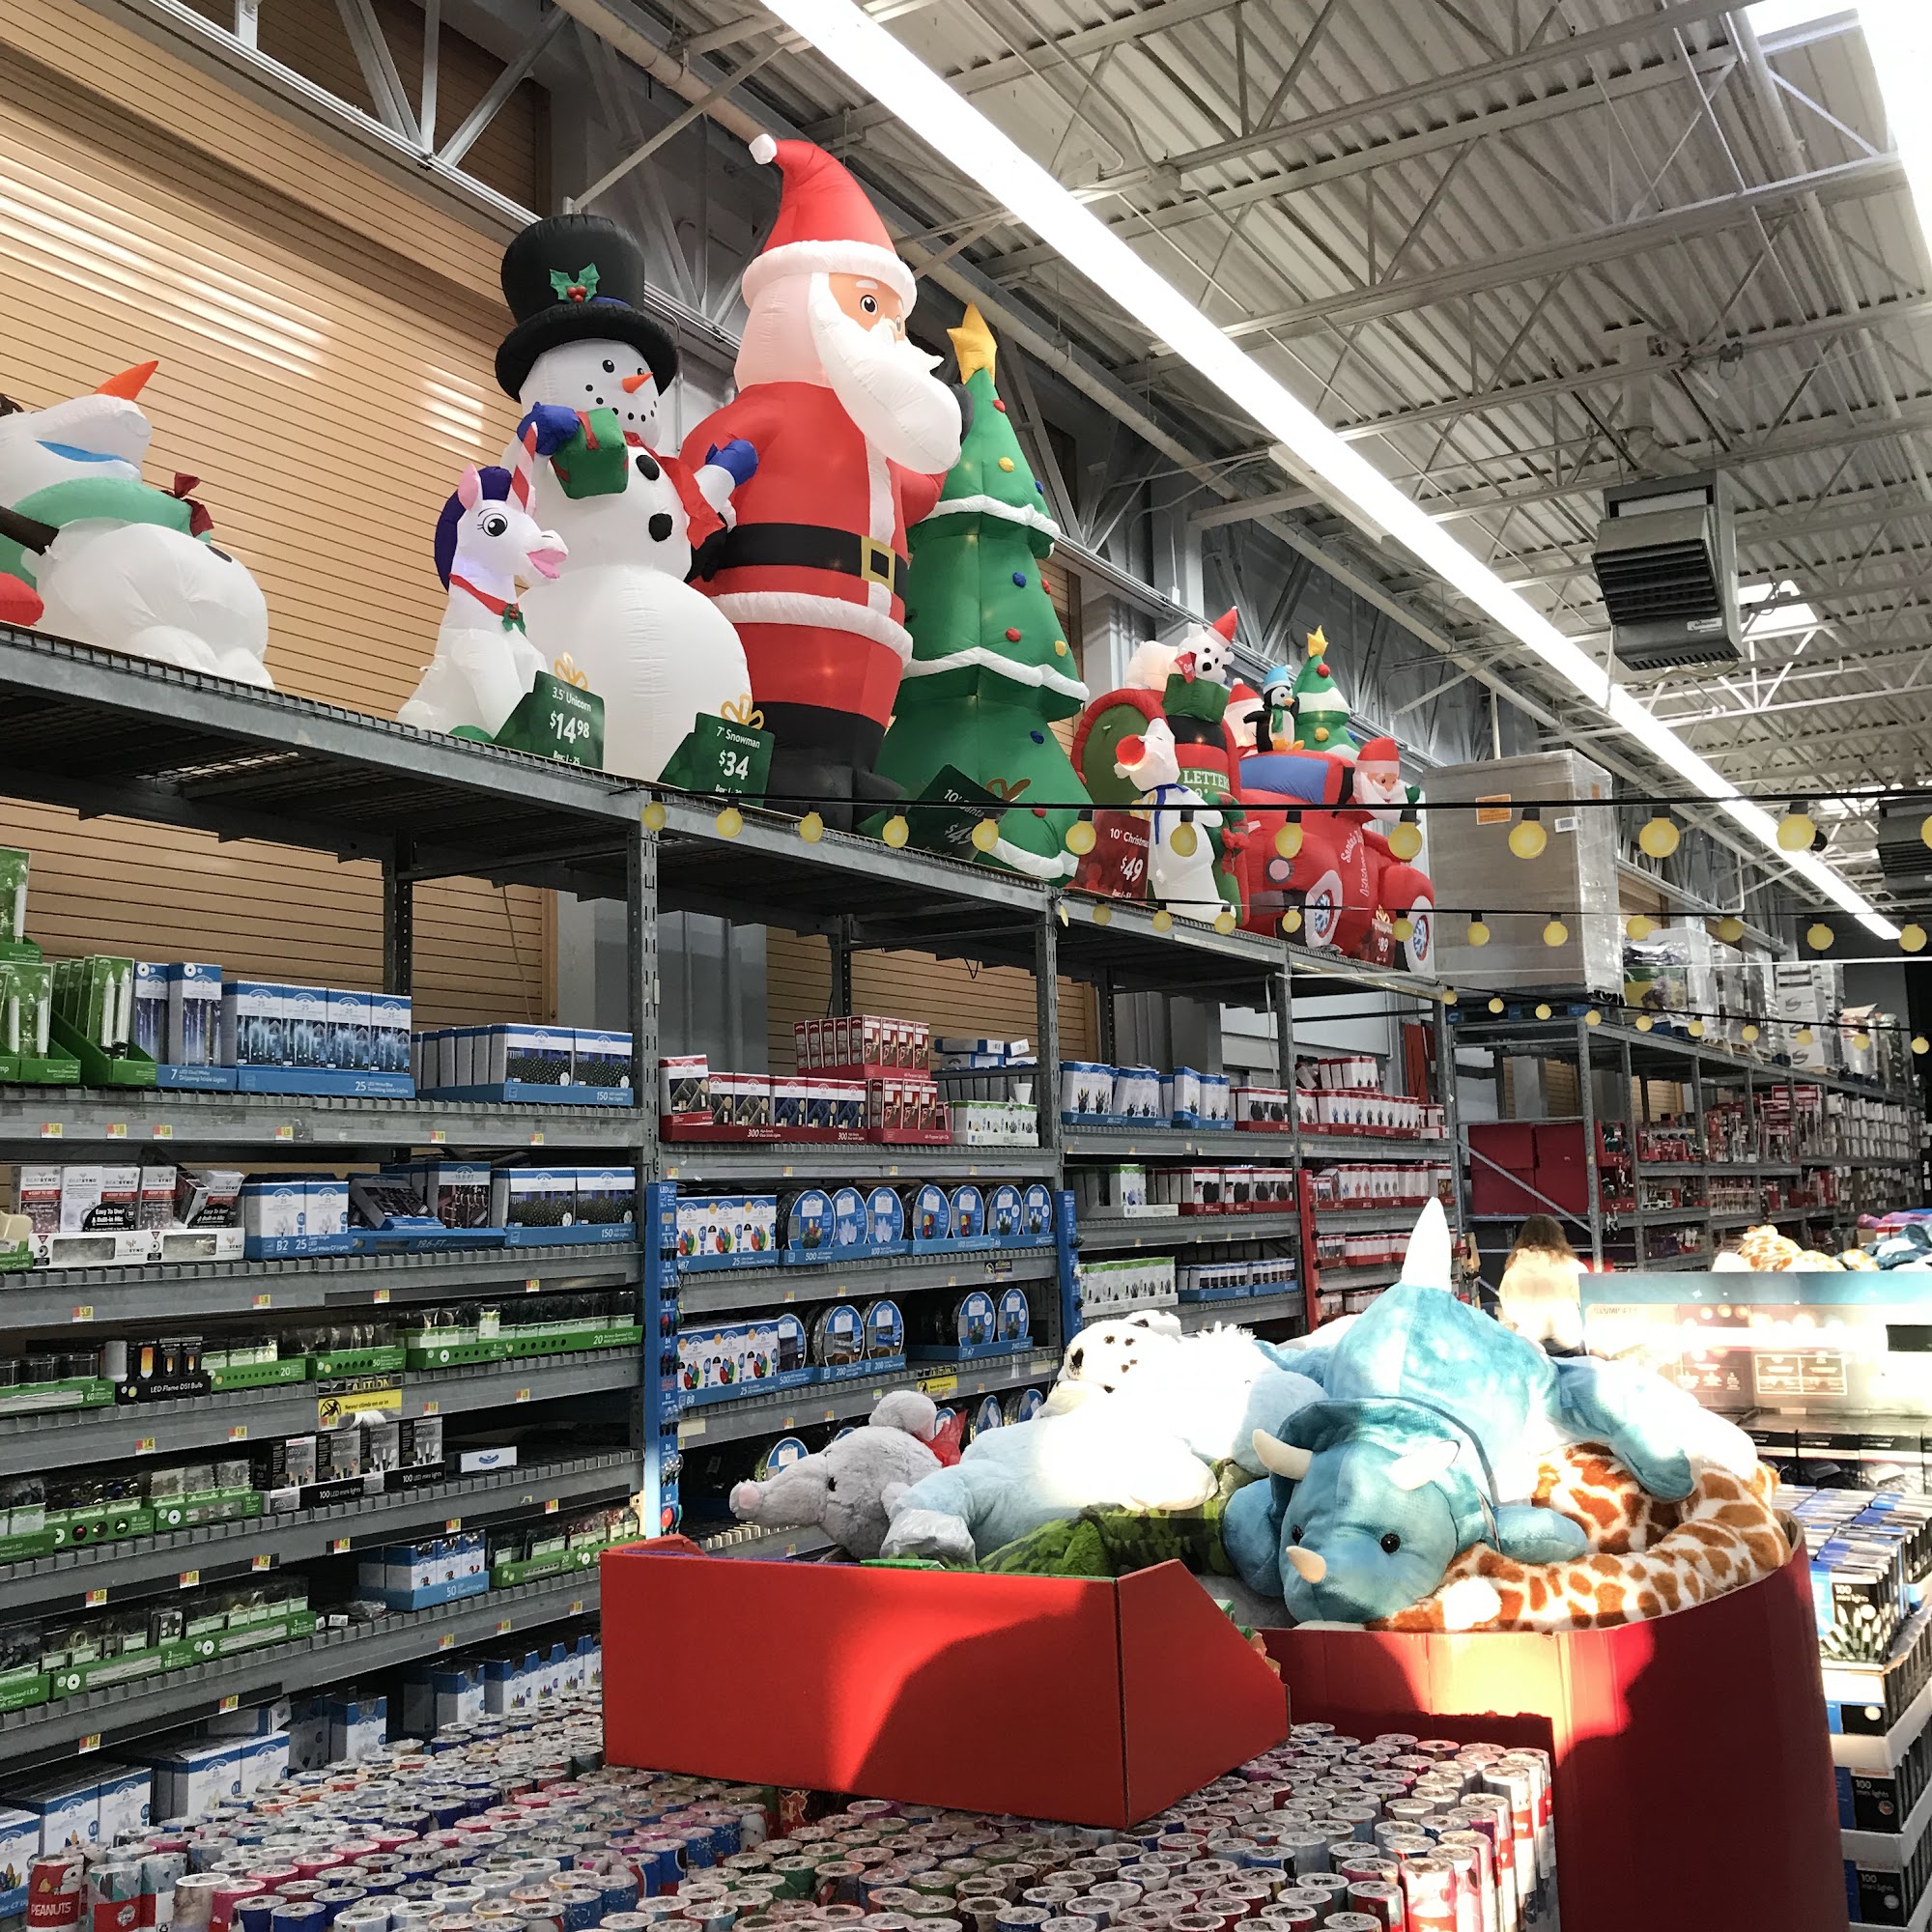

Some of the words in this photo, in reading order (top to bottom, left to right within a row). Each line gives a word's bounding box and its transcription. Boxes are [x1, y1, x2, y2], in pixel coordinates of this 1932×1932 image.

[566, 692, 591, 712] Unicorn
[725, 728, 761, 749] Snowman
[718, 750, 750, 781] $34
[1182, 770, 1231, 792] LETTER
[944, 788, 962, 803] 10'
[1110, 827, 1122, 839] 10'
[1121, 855, 1144, 882] $49
[171, 1068, 179, 1081] 7
[355, 1081, 367, 1092] 25
[596, 1091, 609, 1101] 150
[747, 1128, 760, 1138] 300
[838, 1131, 848, 1141] 300
[601, 1228, 613, 1238] 150
[276, 1239, 289, 1252] B2
[295, 1238, 307, 1250] 25
[805, 1252, 817, 1261] 500
[592, 1334, 604, 1346] 20
[874, 1360, 884, 1370] 200
[280, 1366, 291, 1377] 20
[836, 1367, 847, 1377] 200
[162, 1384, 180, 1393] Flame
[402, 1474, 412, 1483] 100
[319, 1491, 330, 1499] 100
[446, 1585, 457, 1598] 50
[1834, 1584, 1852, 1594] 100
[1856, 1778, 1872, 1790] 100
[1861, 1873, 1877, 1884] 100
[31, 1901, 71, 1917] PEANUTS
